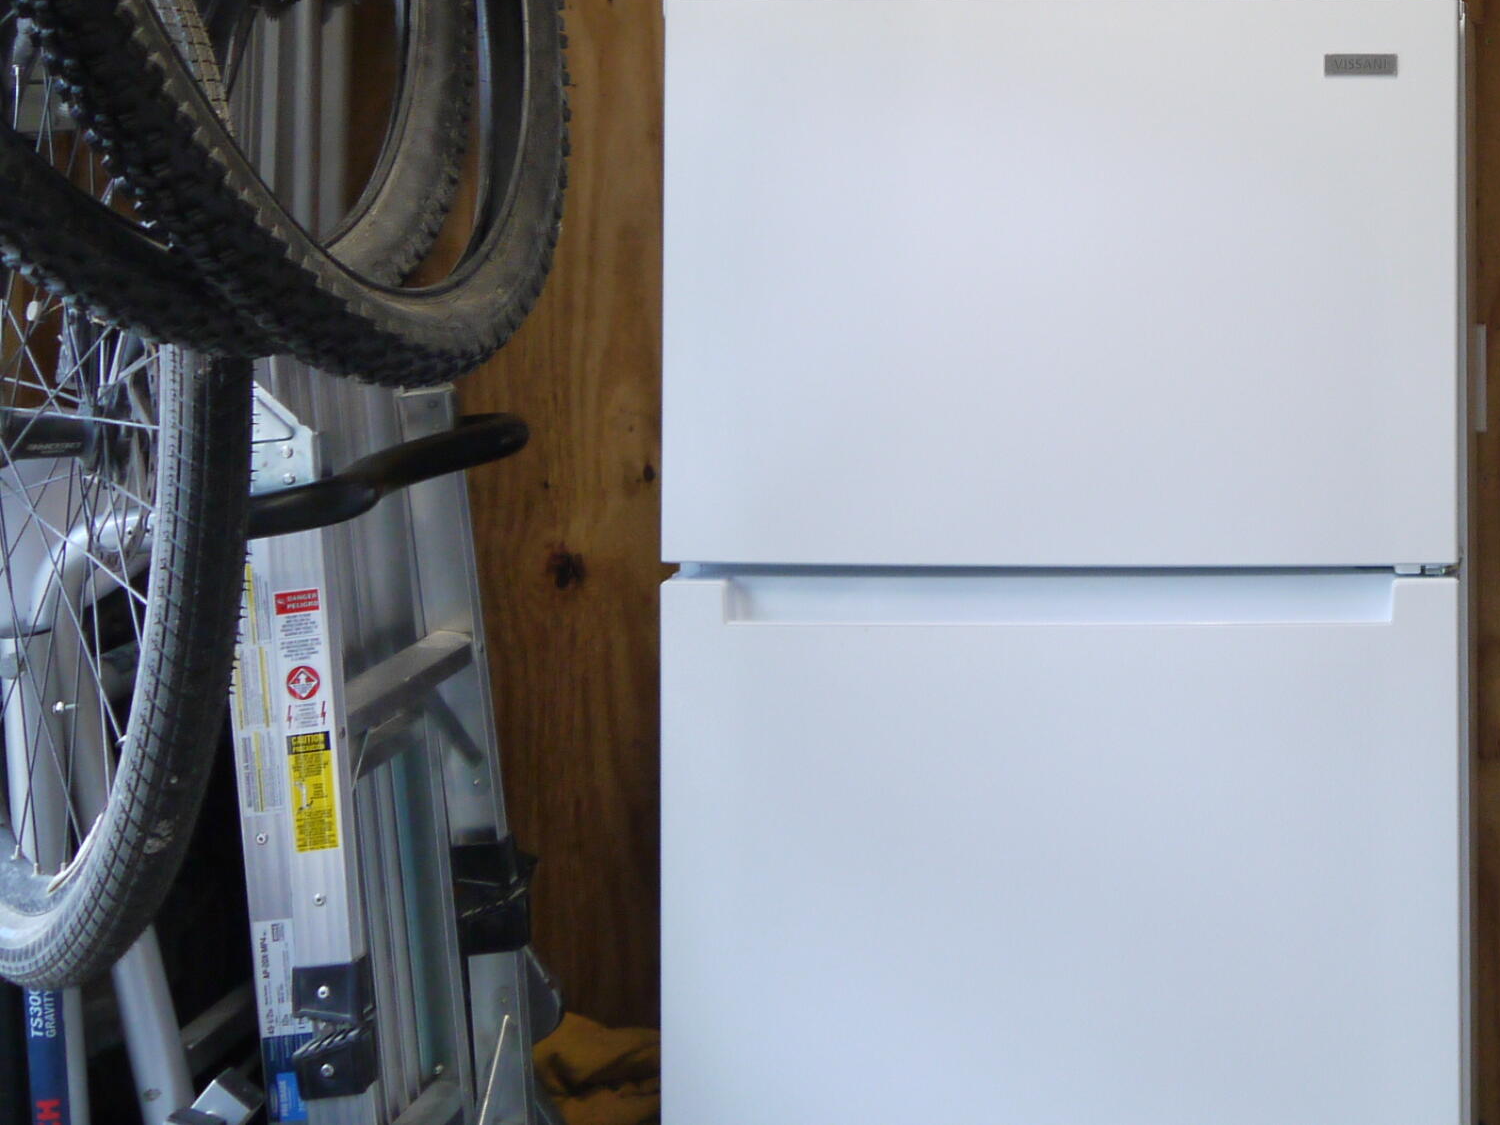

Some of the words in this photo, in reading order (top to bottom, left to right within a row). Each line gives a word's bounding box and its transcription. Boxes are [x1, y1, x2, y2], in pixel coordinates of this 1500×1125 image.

[1334, 58, 1388, 69] VISSANI
[287, 592, 317, 603] DANGER
[287, 600, 319, 610] PELIGRO
